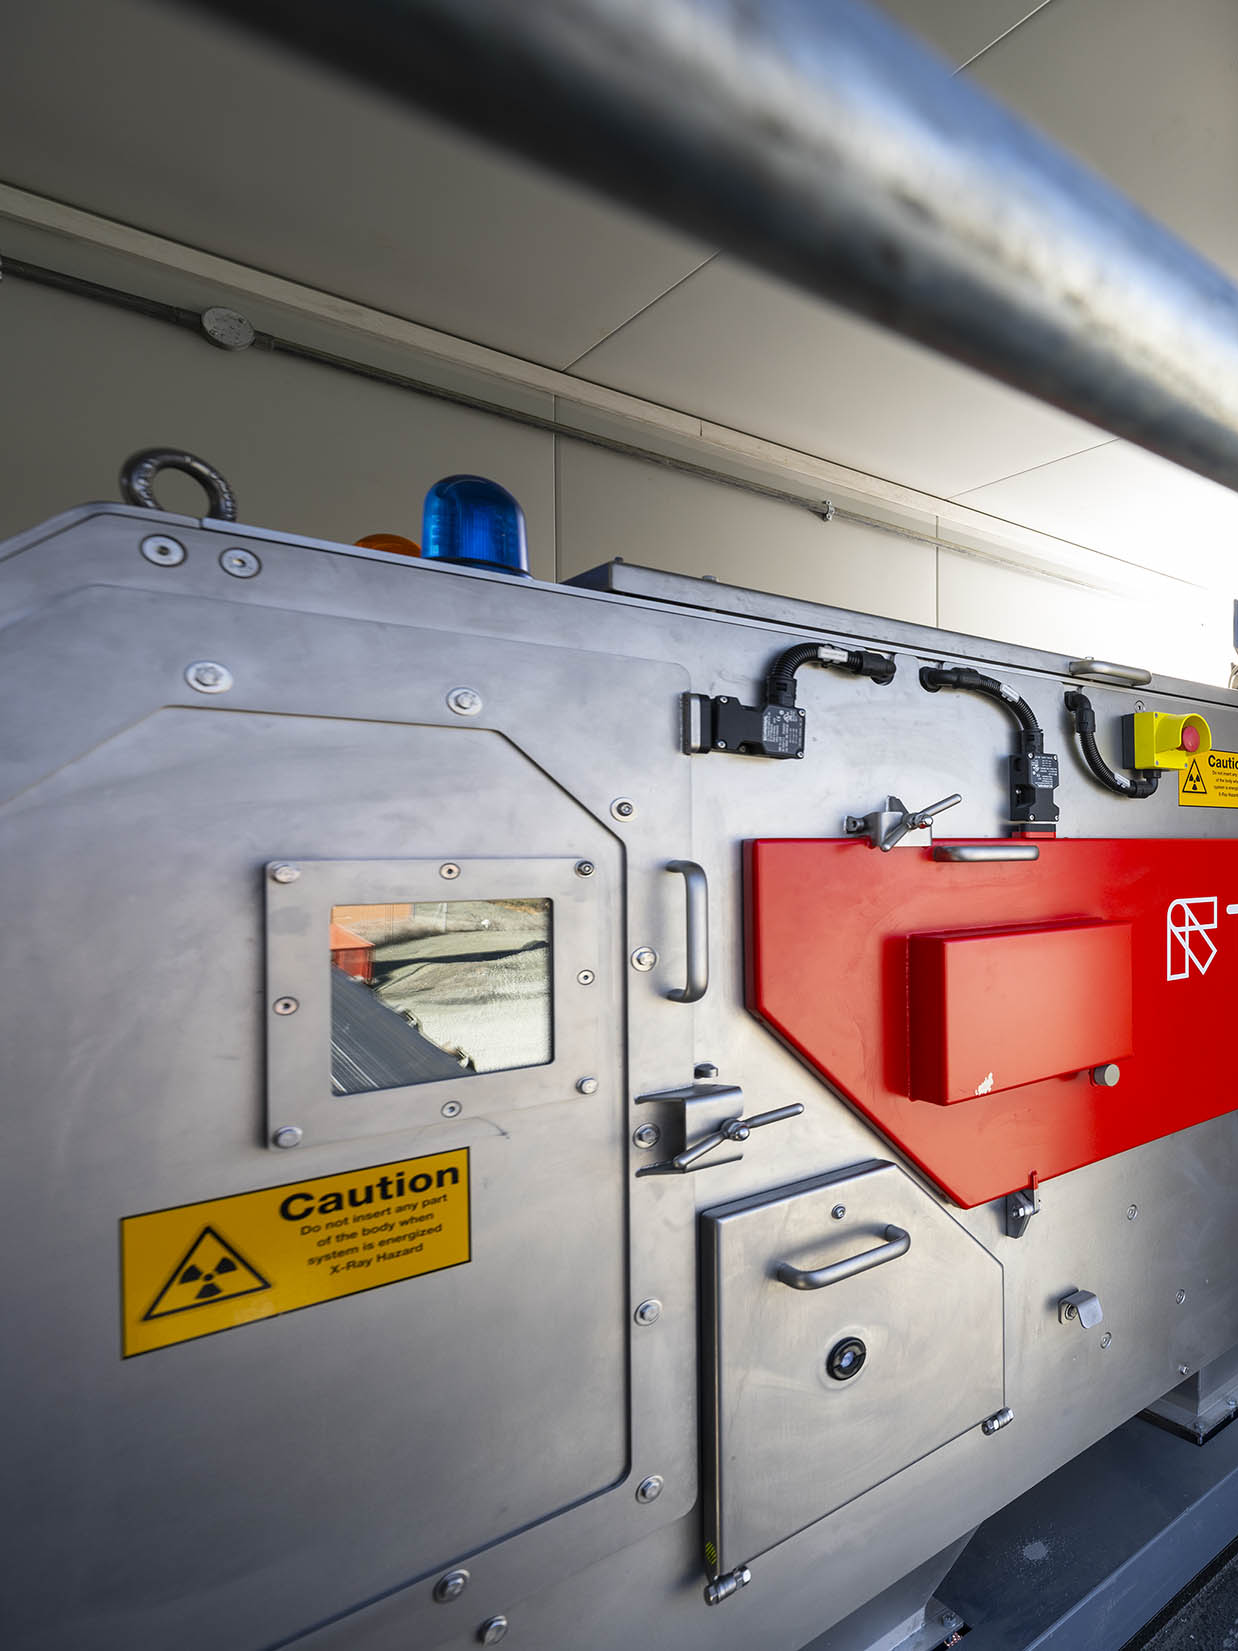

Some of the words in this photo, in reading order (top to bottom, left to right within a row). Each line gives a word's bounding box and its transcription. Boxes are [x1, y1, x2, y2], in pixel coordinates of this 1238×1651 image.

[279, 1166, 460, 1222] Caution
[300, 1224, 321, 1236] Do
[325, 1216, 349, 1229] not
[352, 1207, 392, 1223] insert
[394, 1201, 418, 1214] any
[421, 1194, 448, 1208] part
[307, 1246, 360, 1266] system
[362, 1241, 375, 1251] is
[377, 1223, 443, 1248] energized
[316, 1235, 333, 1248] of
[335, 1229, 359, 1243] the
[361, 1220, 396, 1237] body
[399, 1211, 435, 1227] when
[329, 1257, 374, 1276] X-Ray
[376, 1242, 424, 1263] Hazard
